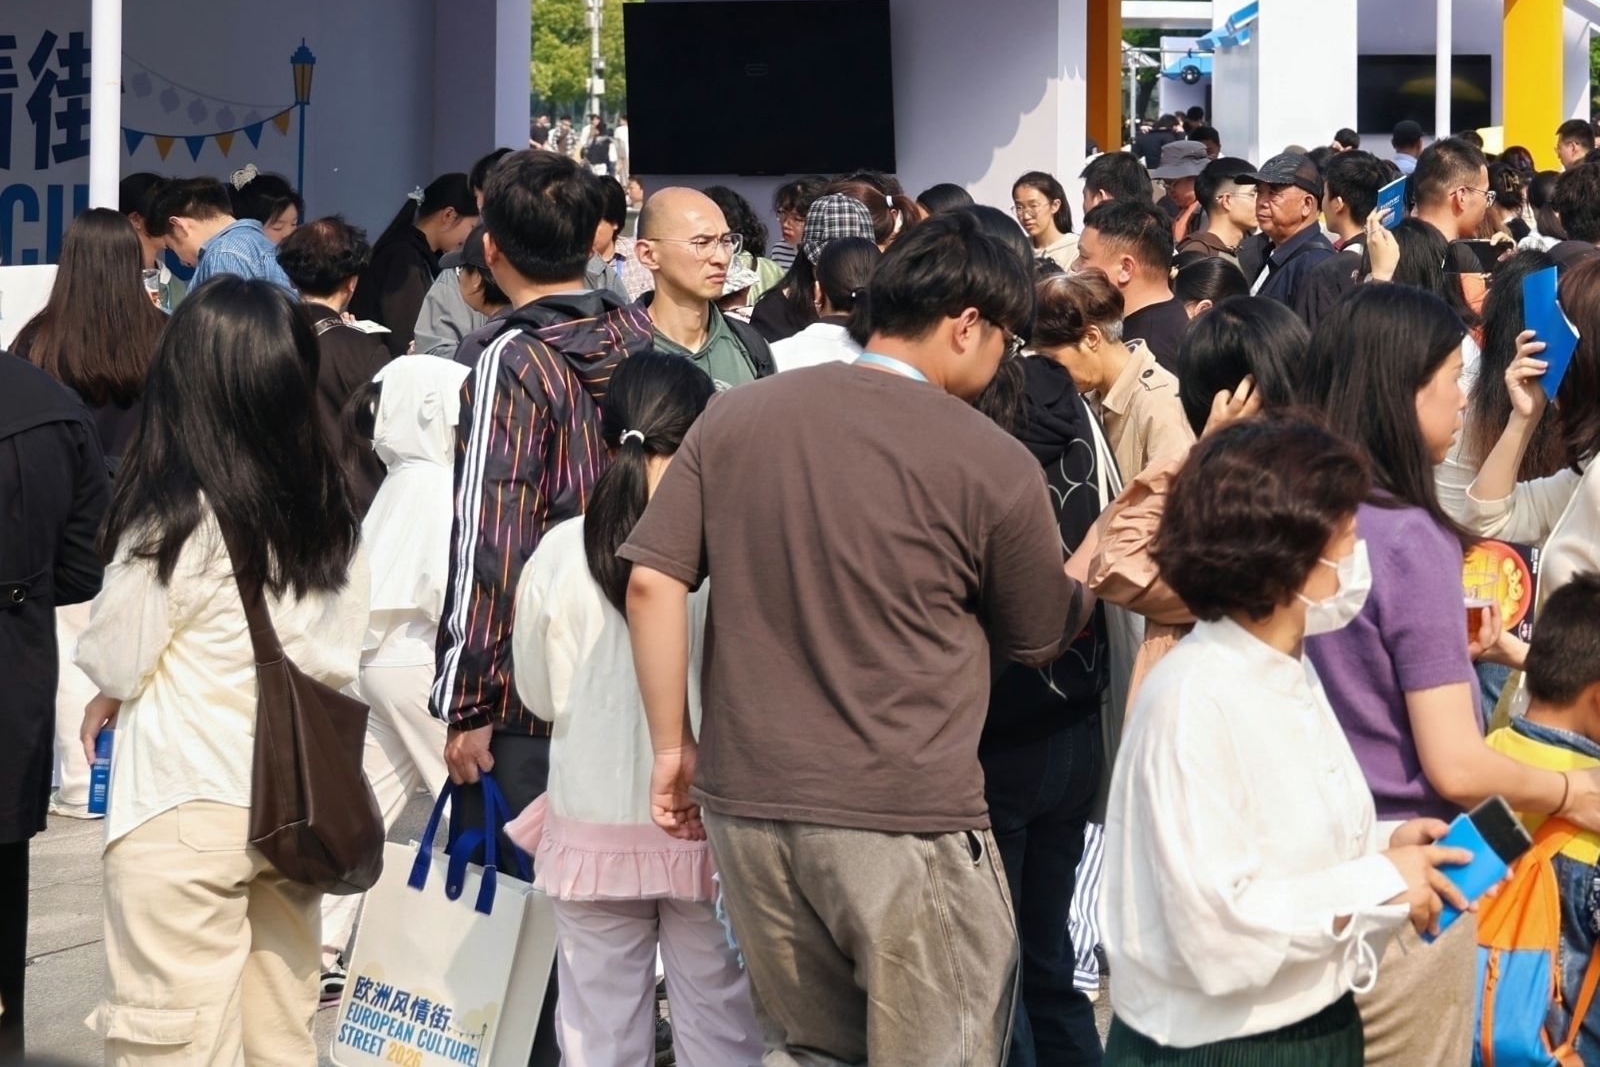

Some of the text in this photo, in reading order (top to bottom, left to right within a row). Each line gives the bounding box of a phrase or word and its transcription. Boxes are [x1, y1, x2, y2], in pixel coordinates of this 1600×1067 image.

[352, 975, 453, 1033] 欧洲风情街
[338, 1023, 424, 1067] STREET 2026
[345, 1001, 478, 1067] EUROPEAN CULTURE
